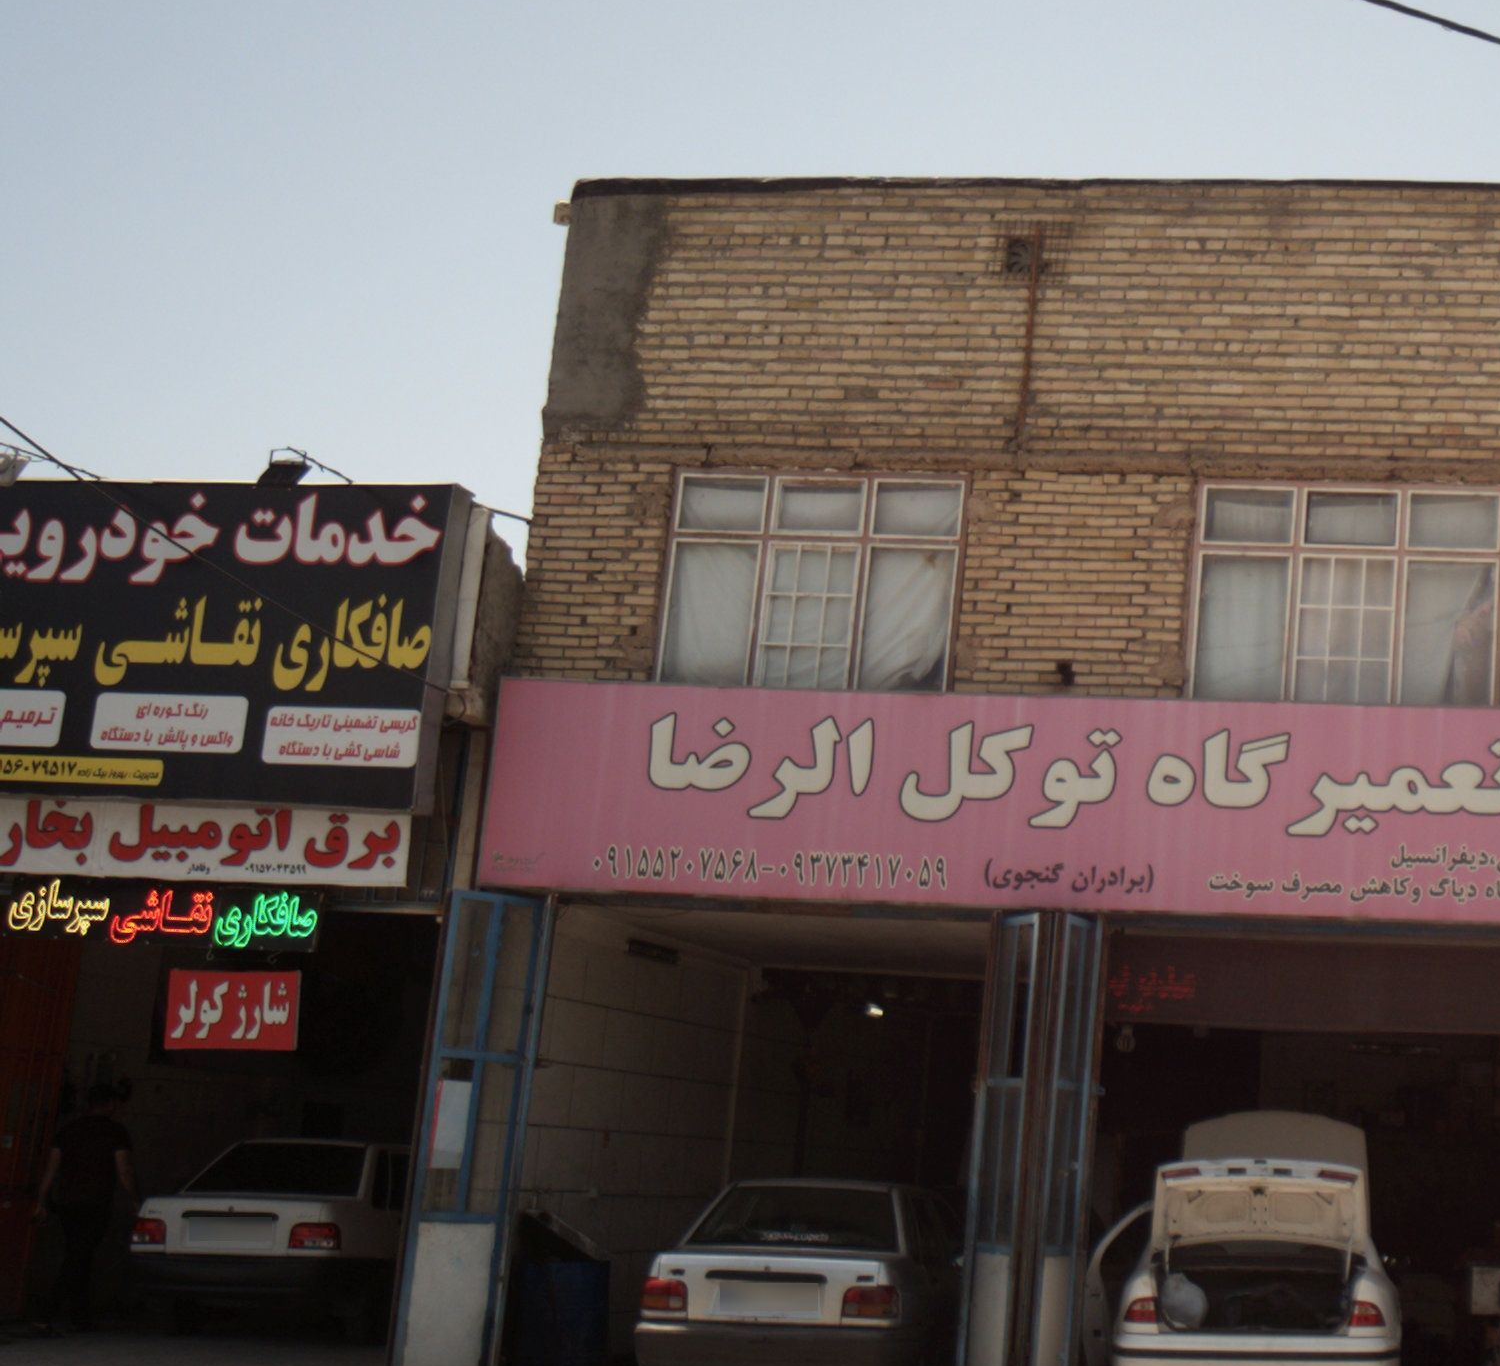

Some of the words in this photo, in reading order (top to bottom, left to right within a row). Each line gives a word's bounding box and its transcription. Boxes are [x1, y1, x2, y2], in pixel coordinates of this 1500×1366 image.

[0, 492, 220, 584] خودروی
[233, 492, 442, 567] خدمات
[94, 595, 263, 685] نقاشی
[272, 593, 431, 692] صافکاری
[184, 702, 209, 720] رنگ
[270, 712, 295, 728] خانه
[297, 714, 331, 731] تاریک
[333, 715, 378, 733] تضمینی
[100, 726, 142, 743] دستگاه
[143, 728, 153, 746] با
[191, 733, 198, 747] و
[200, 729, 234, 748] واکس
[279, 740, 321, 757] دستگاه
[322, 743, 332, 760] با
[333, 740, 362, 761] کشی
[363, 741, 401, 762] شاسی
[648, 711, 876, 820] الرضا
[109, 802, 293, 867] اتومبیل
[304, 812, 401, 870] برق
[1208, 872, 1274, 900] سوخت
[1281, 872, 1343, 901] مصرف
[1428, 877, 1478, 903] دیاگ
[8, 878, 111, 936] سپرسازی
[110, 889, 214, 944] نقاشی
[214, 890, 318, 949] صافکاری
[171, 979, 230, 1039] کولر
[231, 980, 291, 1040] شارژ
